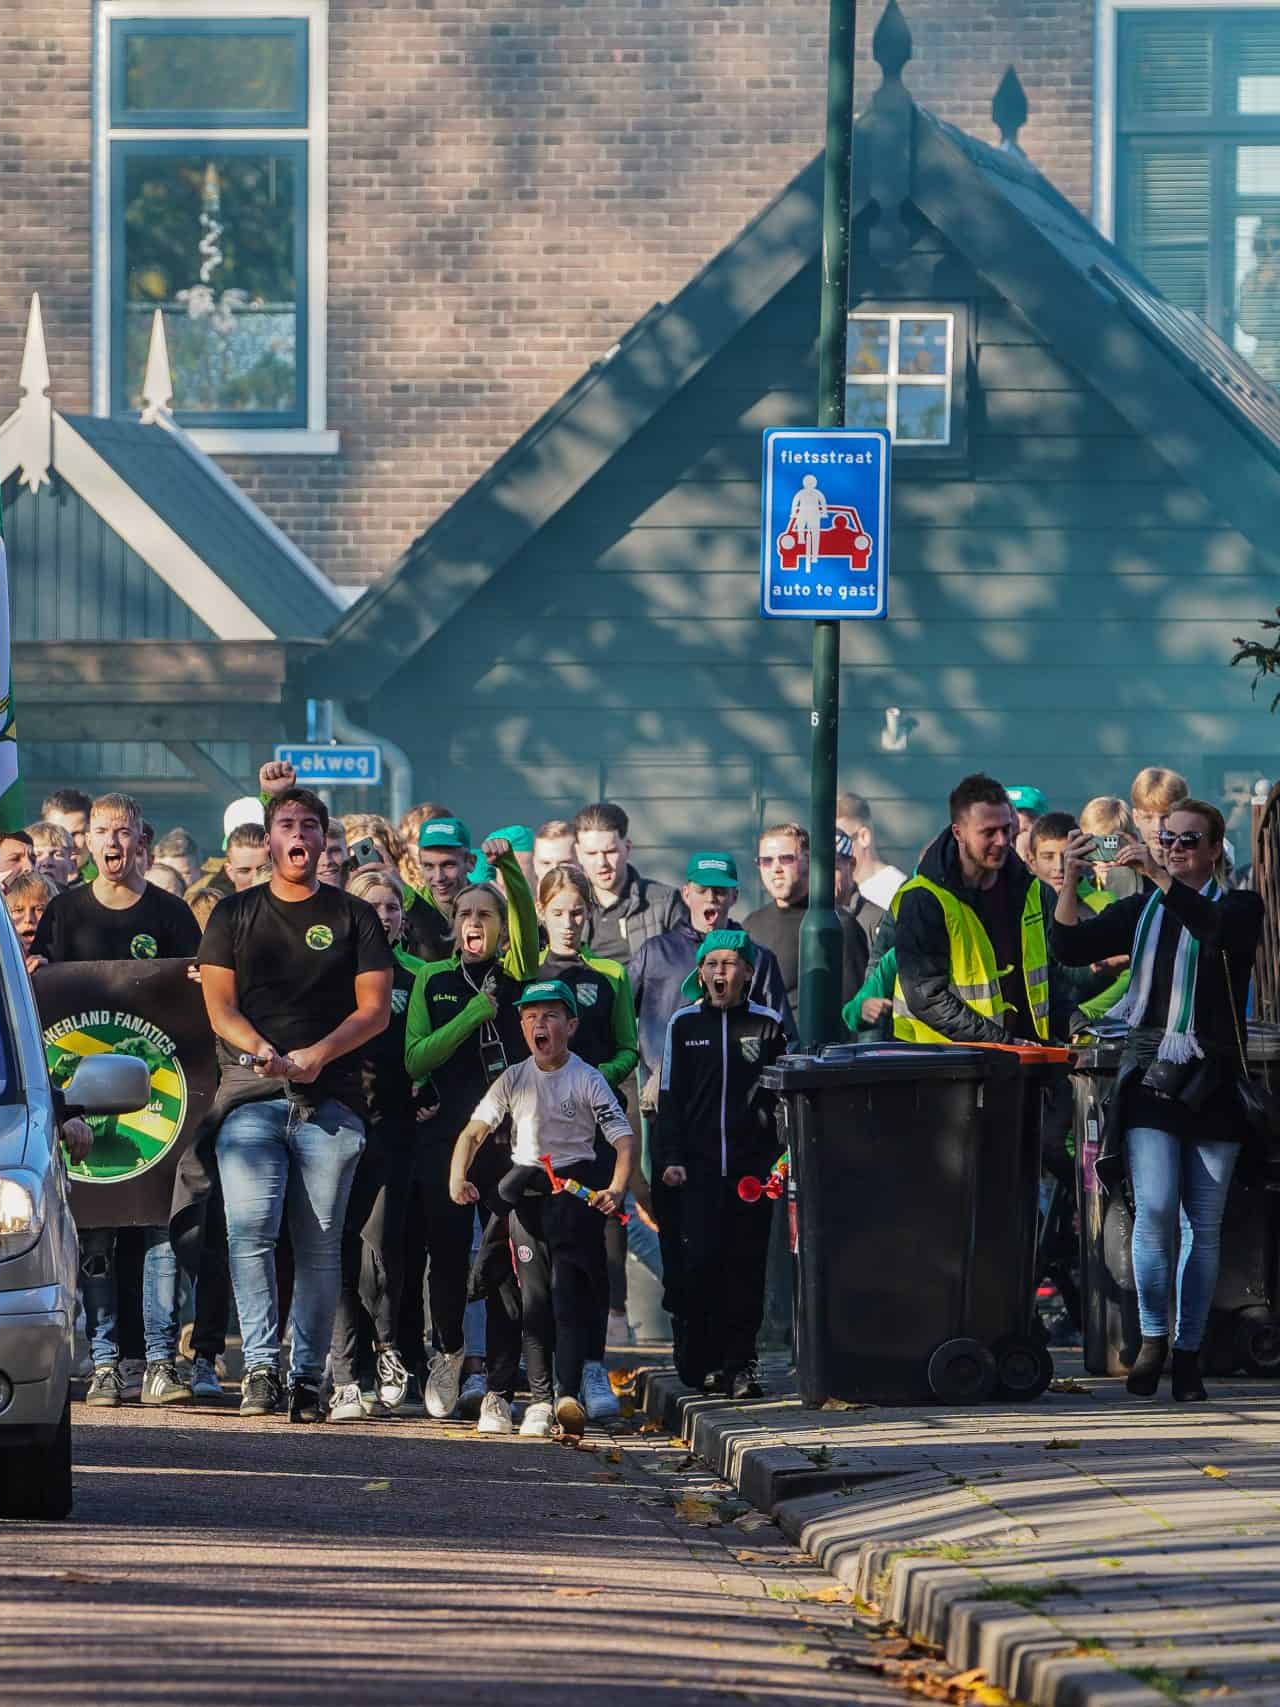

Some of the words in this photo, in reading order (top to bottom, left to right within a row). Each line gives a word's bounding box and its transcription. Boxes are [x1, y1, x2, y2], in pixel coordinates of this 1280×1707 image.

[780, 450, 873, 464] fietsstraat
[772, 583, 810, 596] auto
[816, 583, 833, 596] te
[838, 583, 877, 600] gast
[810, 711, 819, 727] 6
[42, 1010, 111, 1046] KERLAND
[114, 1011, 177, 1057] FANATICS
